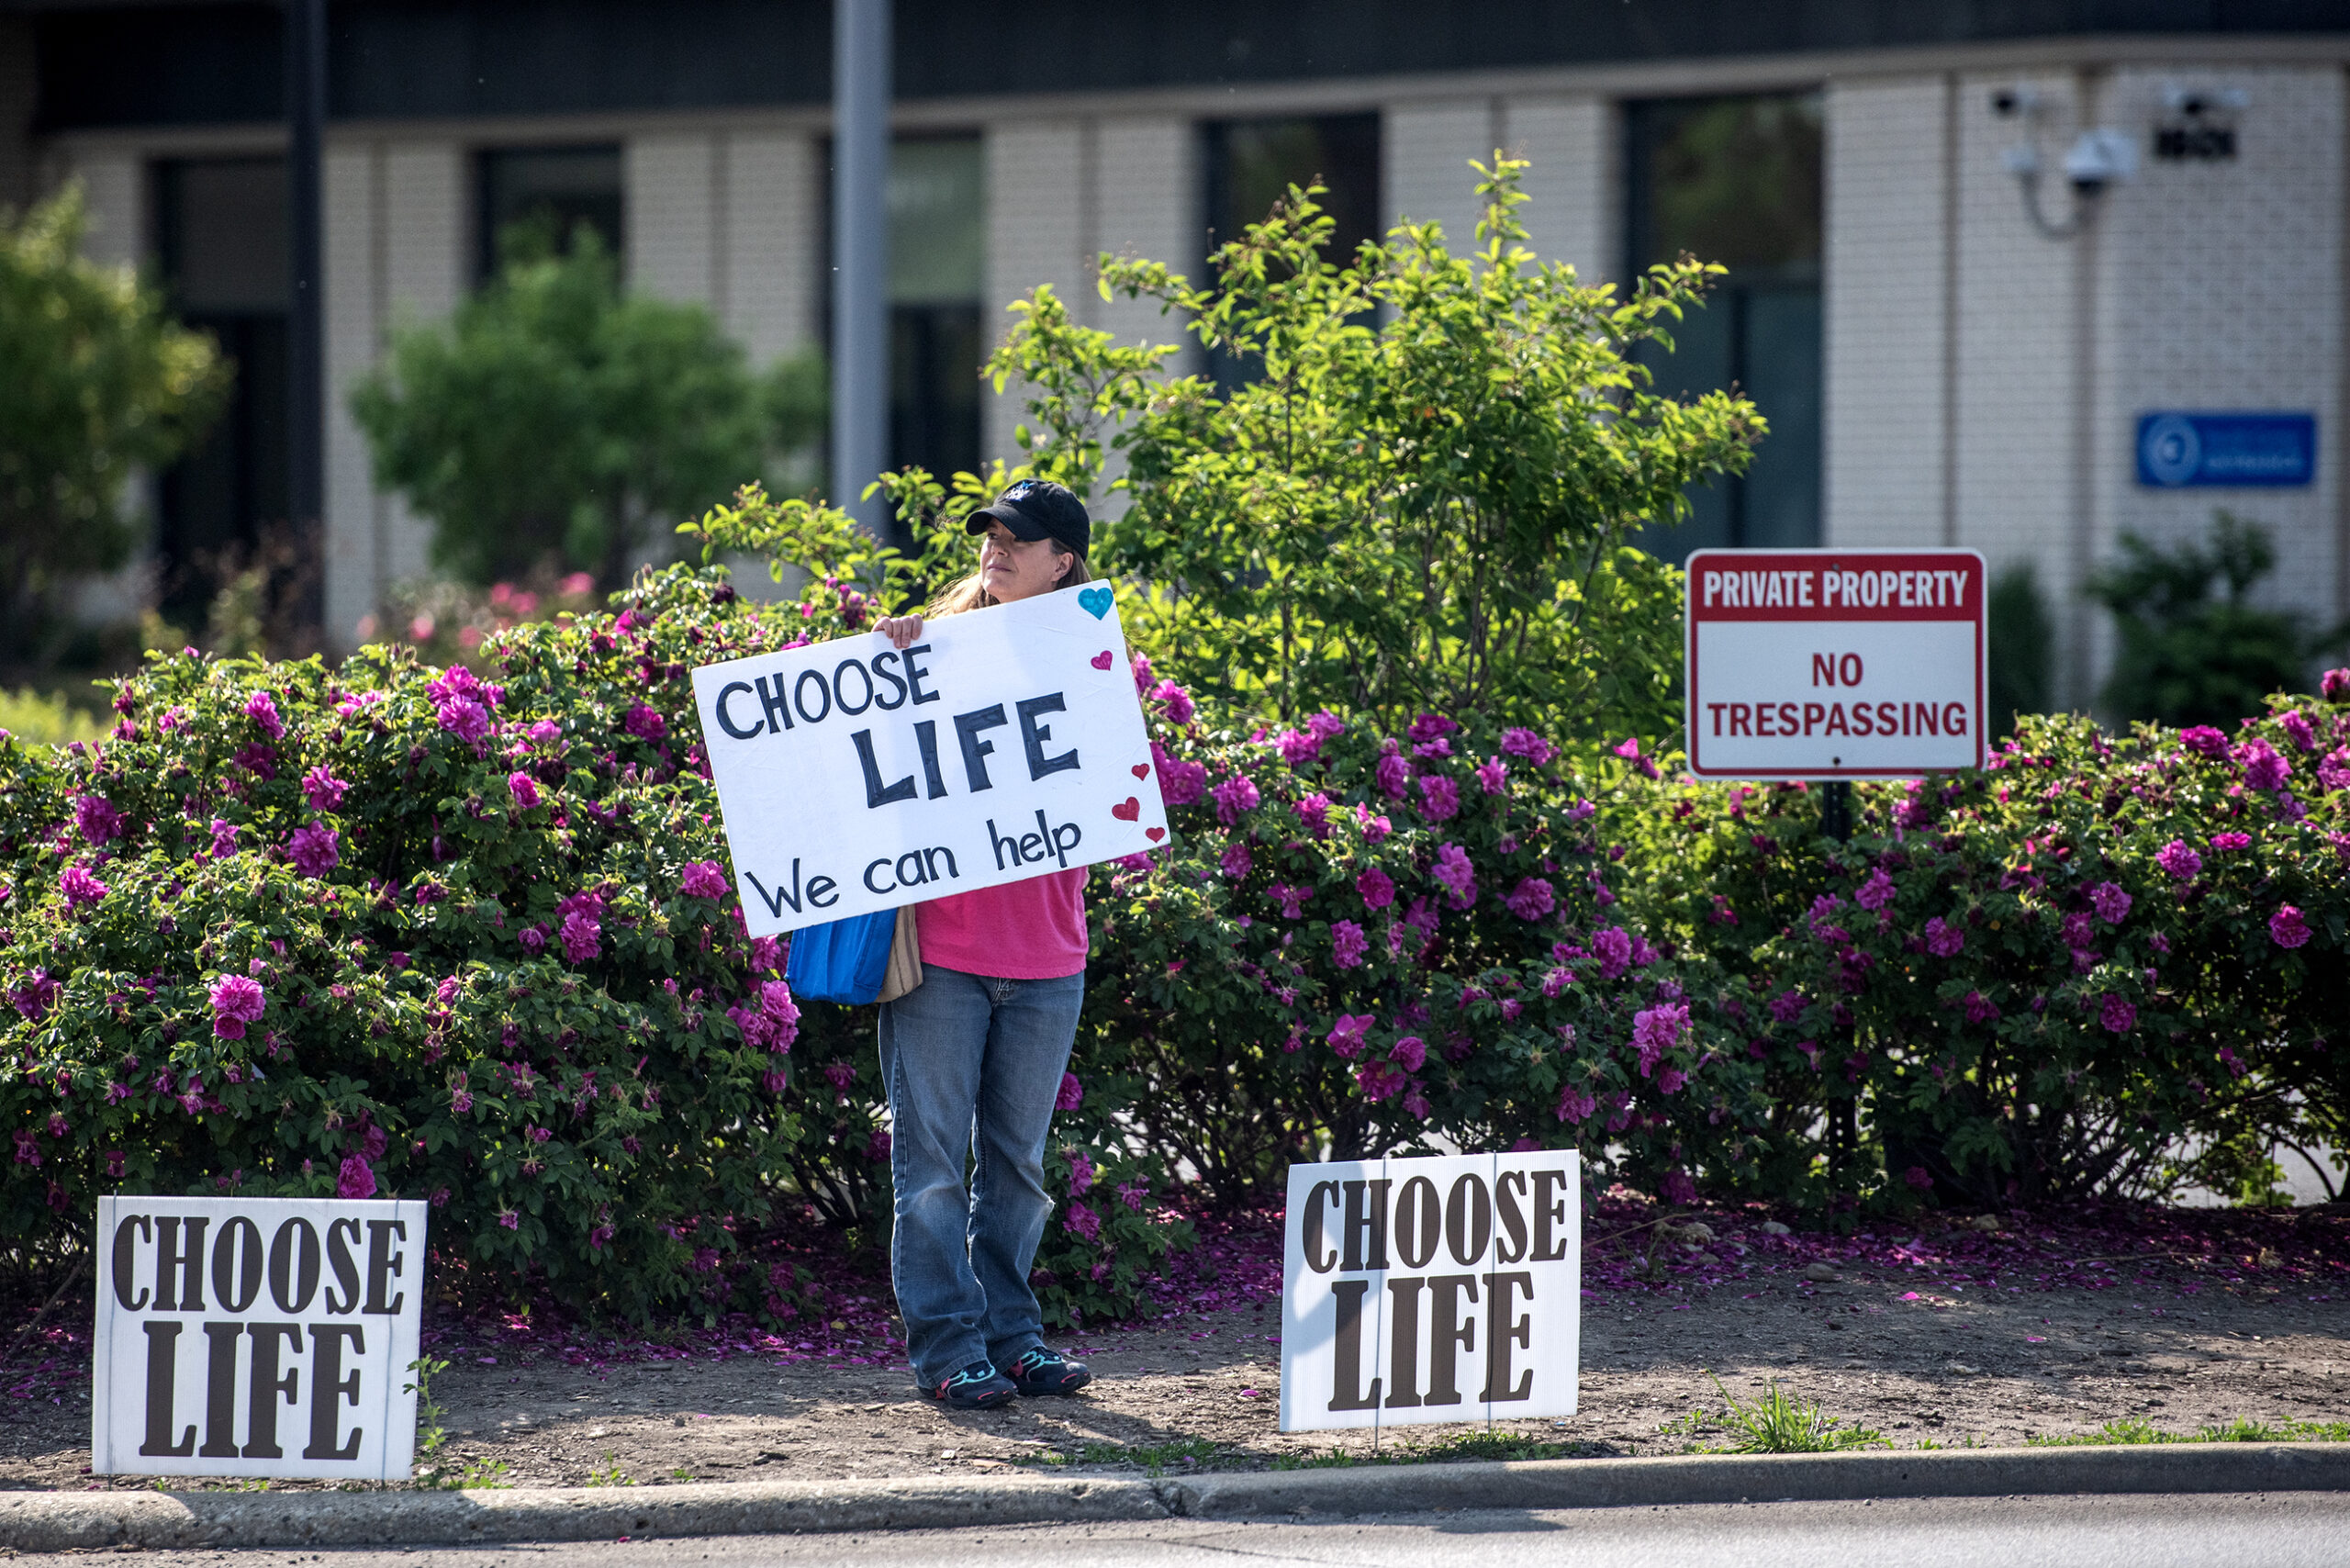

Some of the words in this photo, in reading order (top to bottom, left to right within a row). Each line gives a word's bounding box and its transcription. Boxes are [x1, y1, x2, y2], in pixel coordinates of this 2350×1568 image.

[1703, 570, 1815, 607] PRIVATE
[1823, 570, 1968, 607] PROPERTY
[716, 644, 940, 739] CHOOSE
[1707, 702, 1967, 736] TRESPASSING
[1812, 653, 1863, 687] NO
[851, 691, 1080, 808] LIFE
[744, 858, 840, 917] We
[864, 846, 959, 894] can
[987, 810, 1081, 870] help
[112, 1214, 407, 1315] CHOOSE
[1302, 1170, 1567, 1274] CHOOSE
[139, 1320, 365, 1461] LIFE
[1327, 1271, 1534, 1412] LIFE
